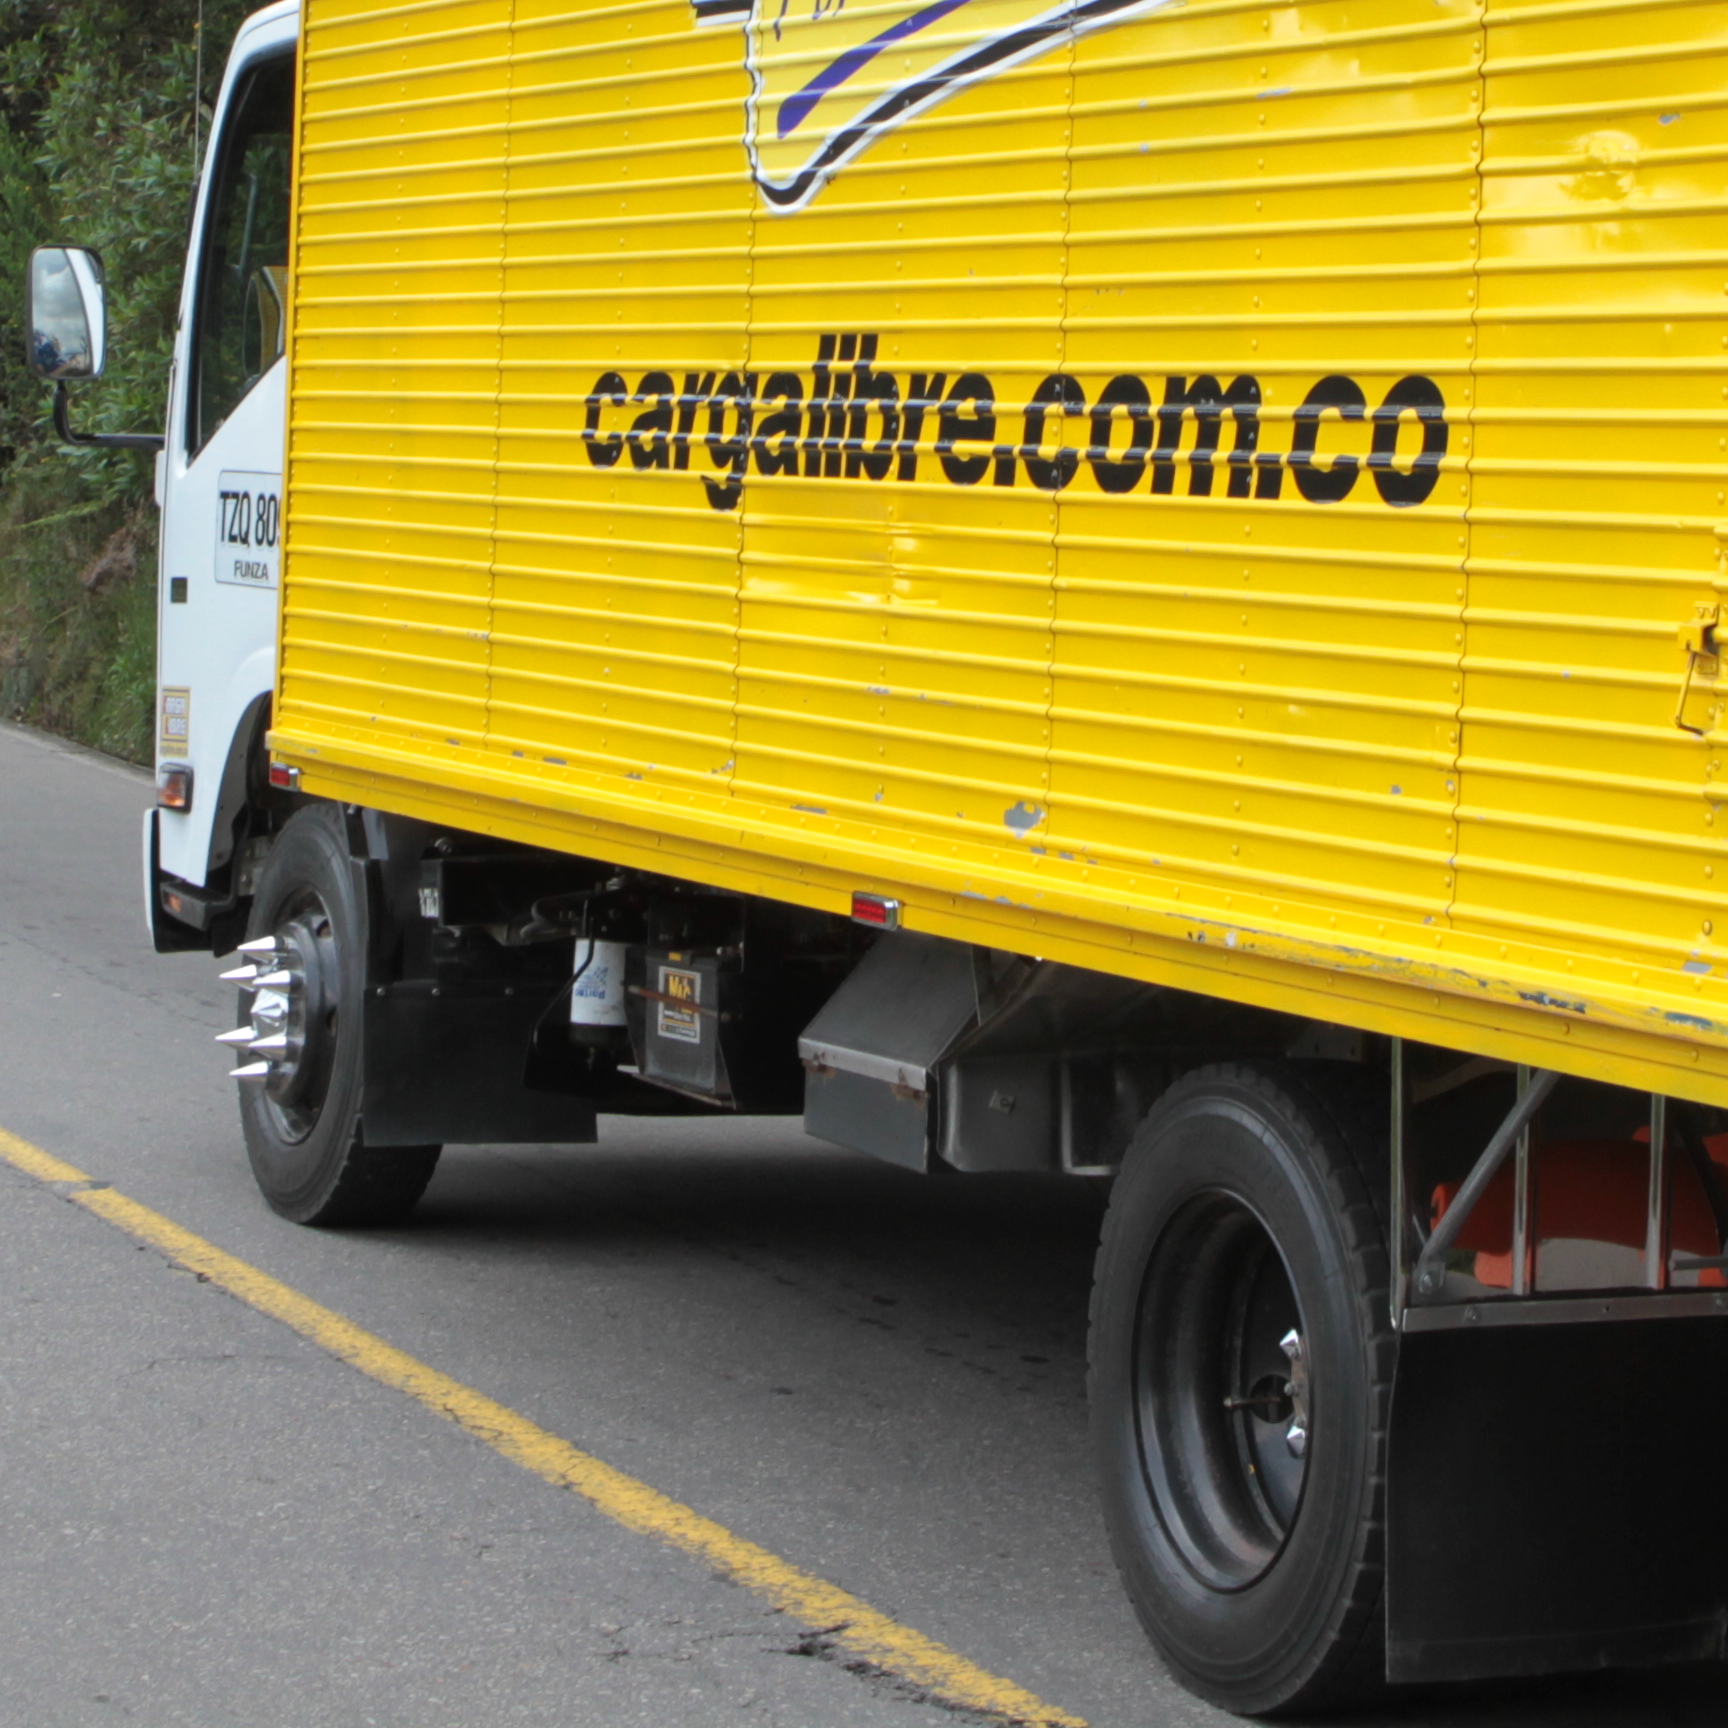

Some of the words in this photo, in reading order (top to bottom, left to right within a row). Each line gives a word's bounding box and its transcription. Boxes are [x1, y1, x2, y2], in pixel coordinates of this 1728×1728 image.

[583, 332, 1450, 511] cargalibre.com.co
[219, 489, 252, 548] TZQ
[255, 493, 282, 548] 80
[234, 559, 269, 581] FUNZA
